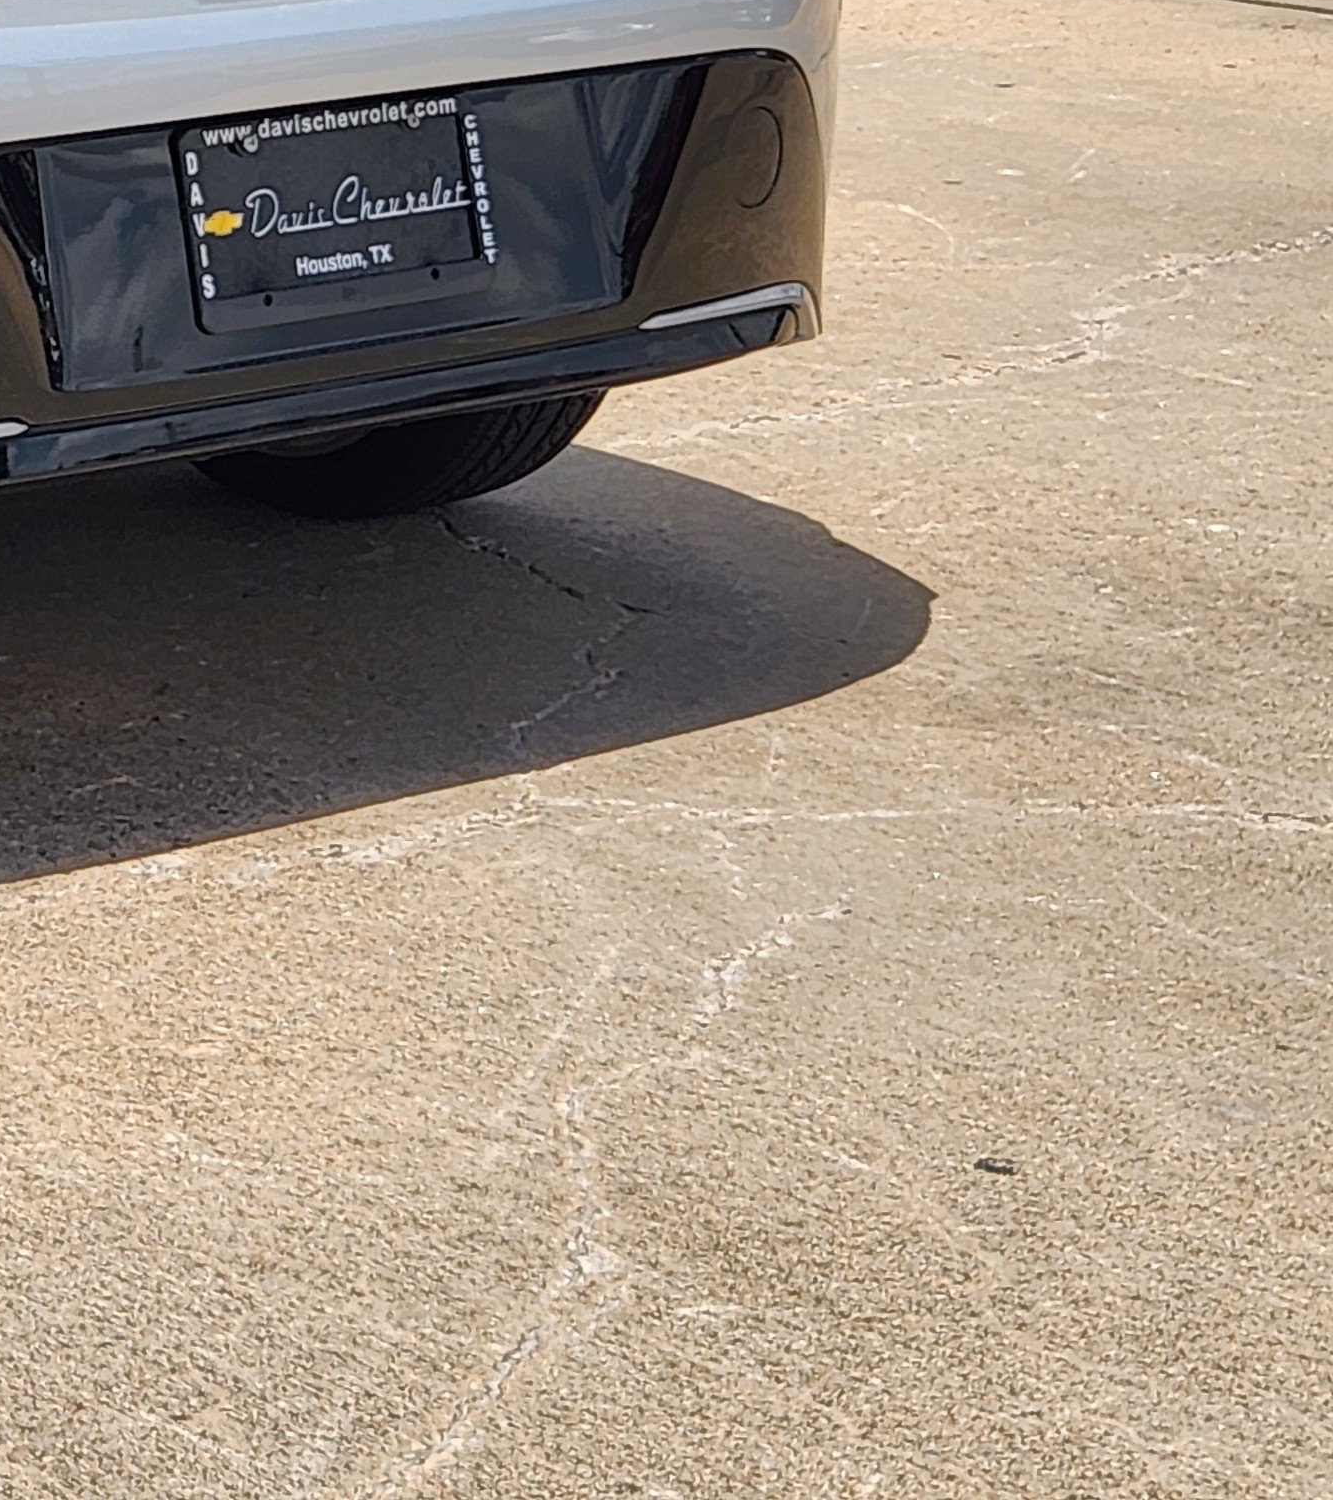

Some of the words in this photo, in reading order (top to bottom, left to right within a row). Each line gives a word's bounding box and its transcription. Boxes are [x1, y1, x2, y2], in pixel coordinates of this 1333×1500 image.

[185, 151, 217, 300] DAVIS
[244, 188, 333, 238] Davis
[333, 175, 472, 225] Chevrolet
[464, 113, 500, 265] CHEVROLET
[295, 249, 368, 277] Houston,
[368, 243, 394, 264] TX
